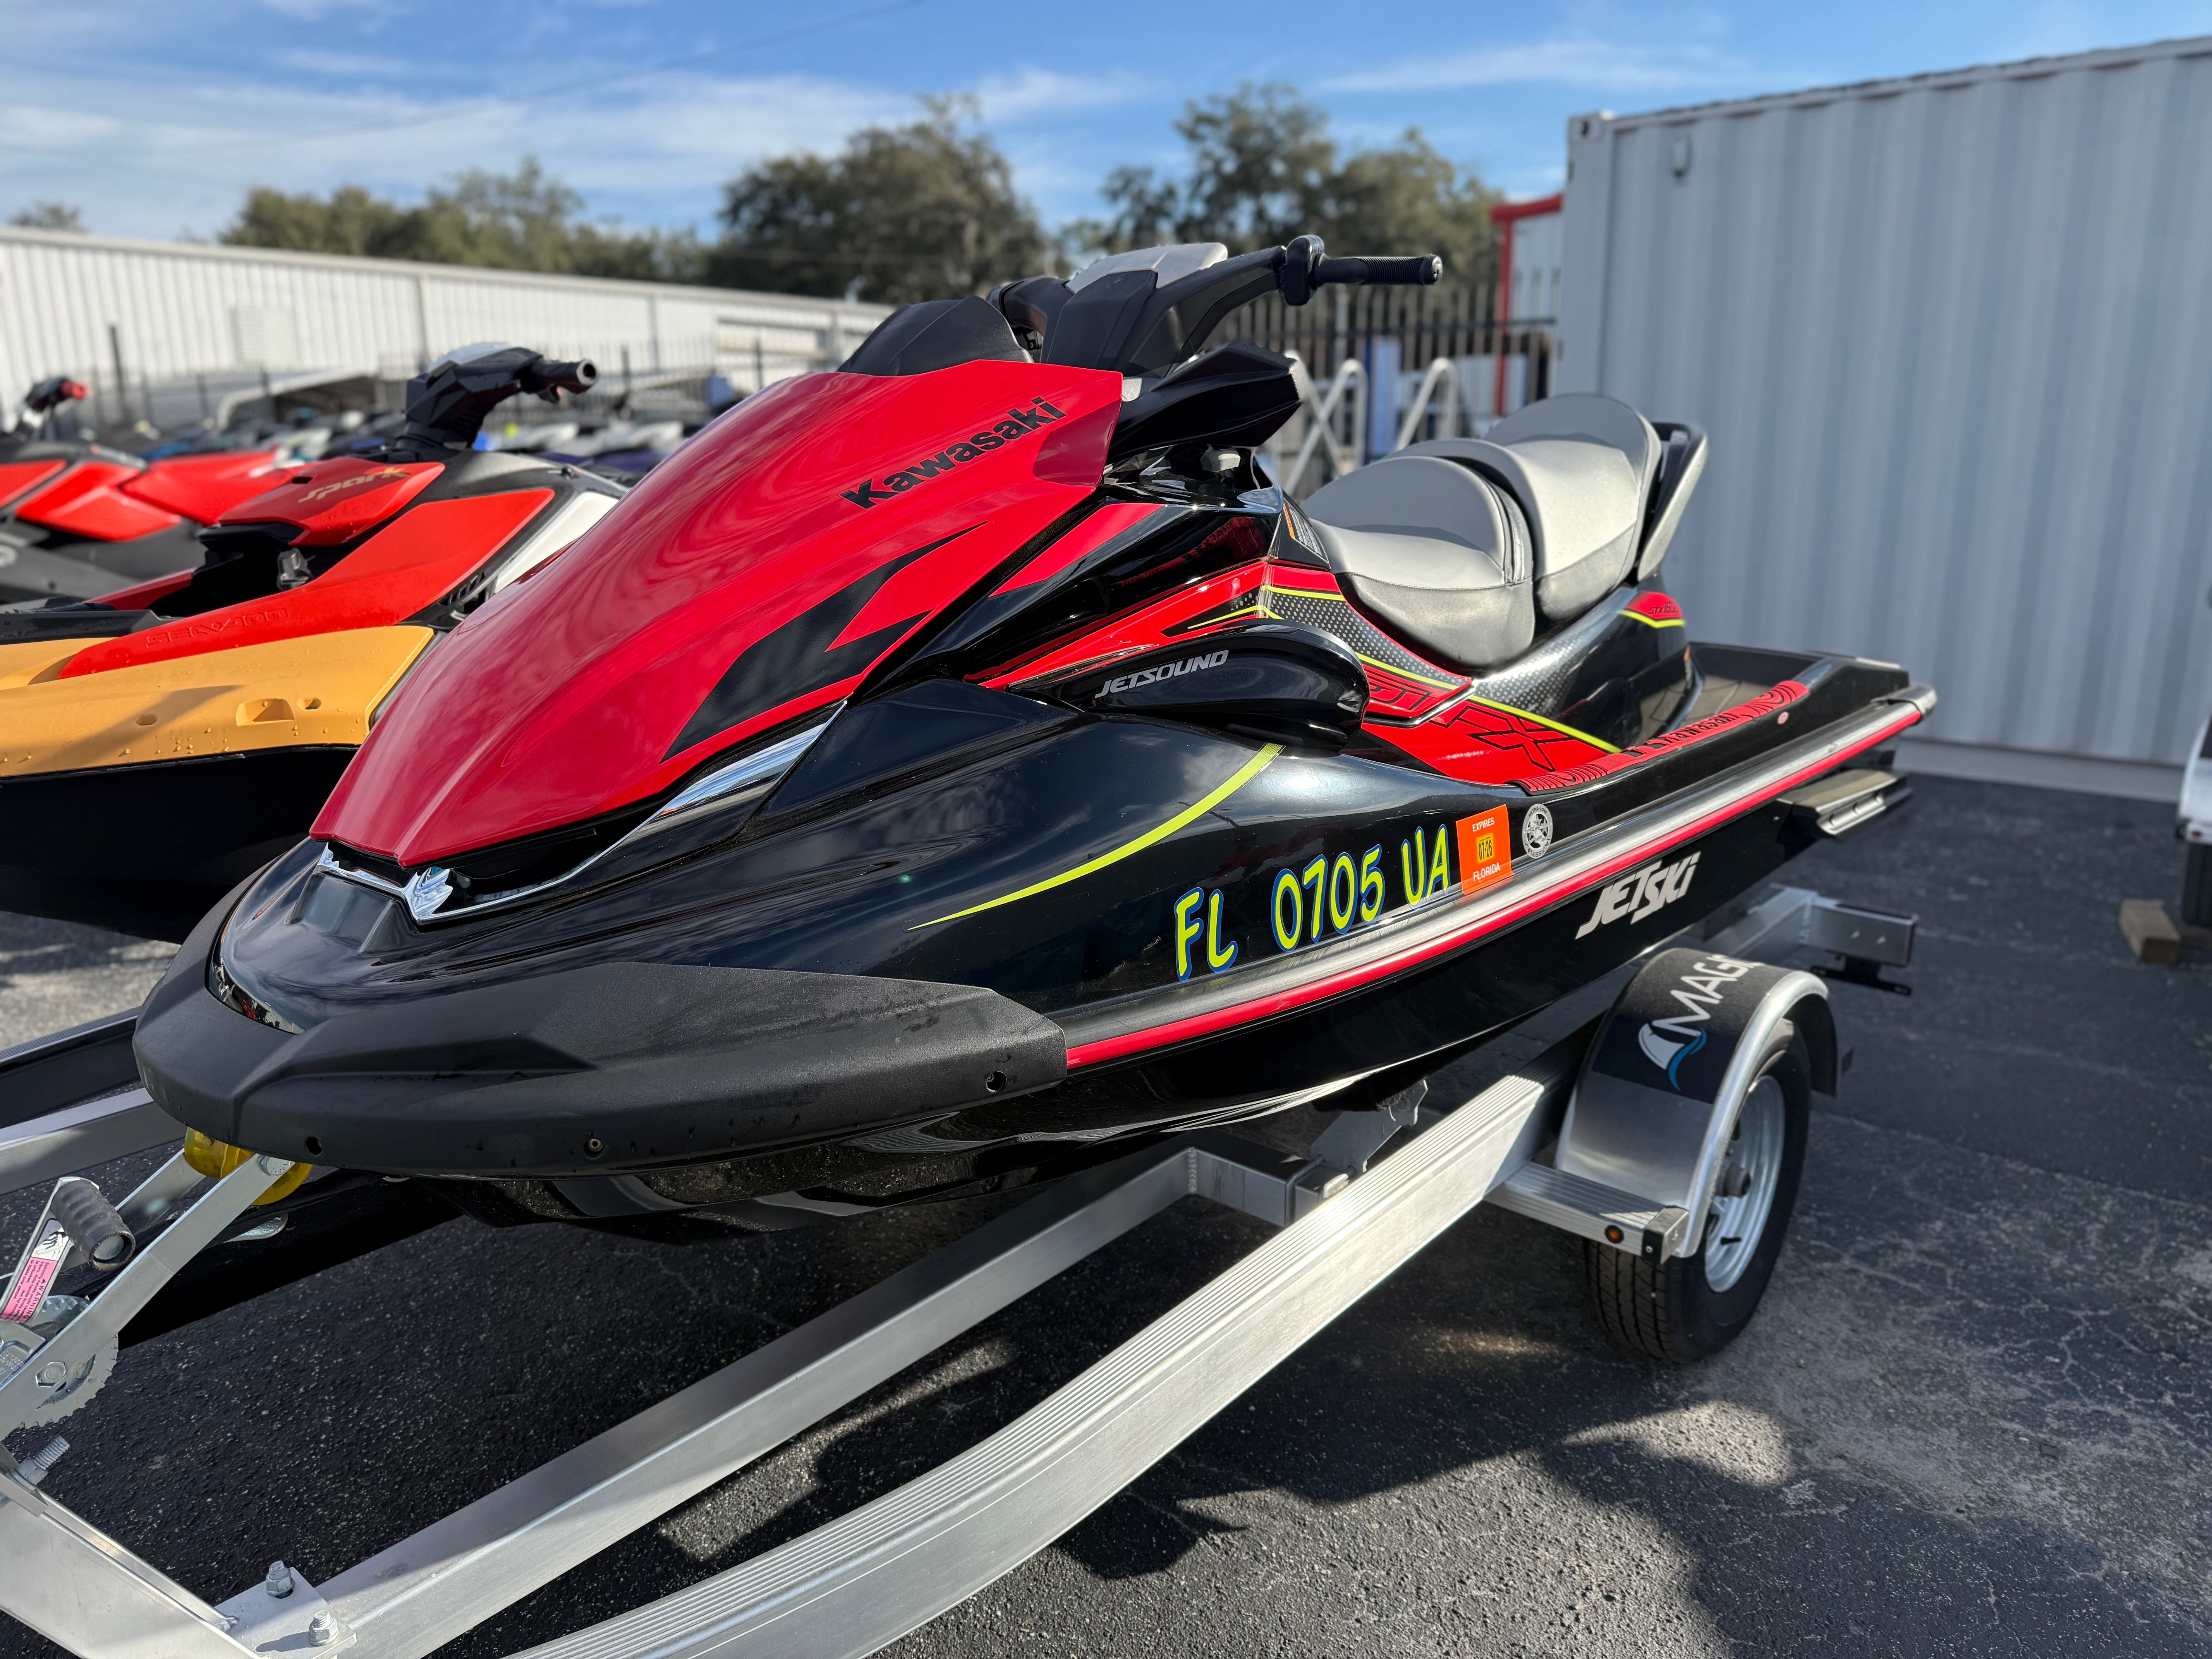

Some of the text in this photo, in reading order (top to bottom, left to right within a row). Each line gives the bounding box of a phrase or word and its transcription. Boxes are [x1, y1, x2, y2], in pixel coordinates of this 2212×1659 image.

[840, 397, 1066, 509] Kawasaki
[1094, 650, 1229, 698] JETSOUND
[1472, 817, 1495, 832] EXPIRES
[1473, 862, 1501, 881] FLORIDA
[1174, 824, 1451, 982] FL 0705 UA
[23, 1285, 44, 1318] WARNING
